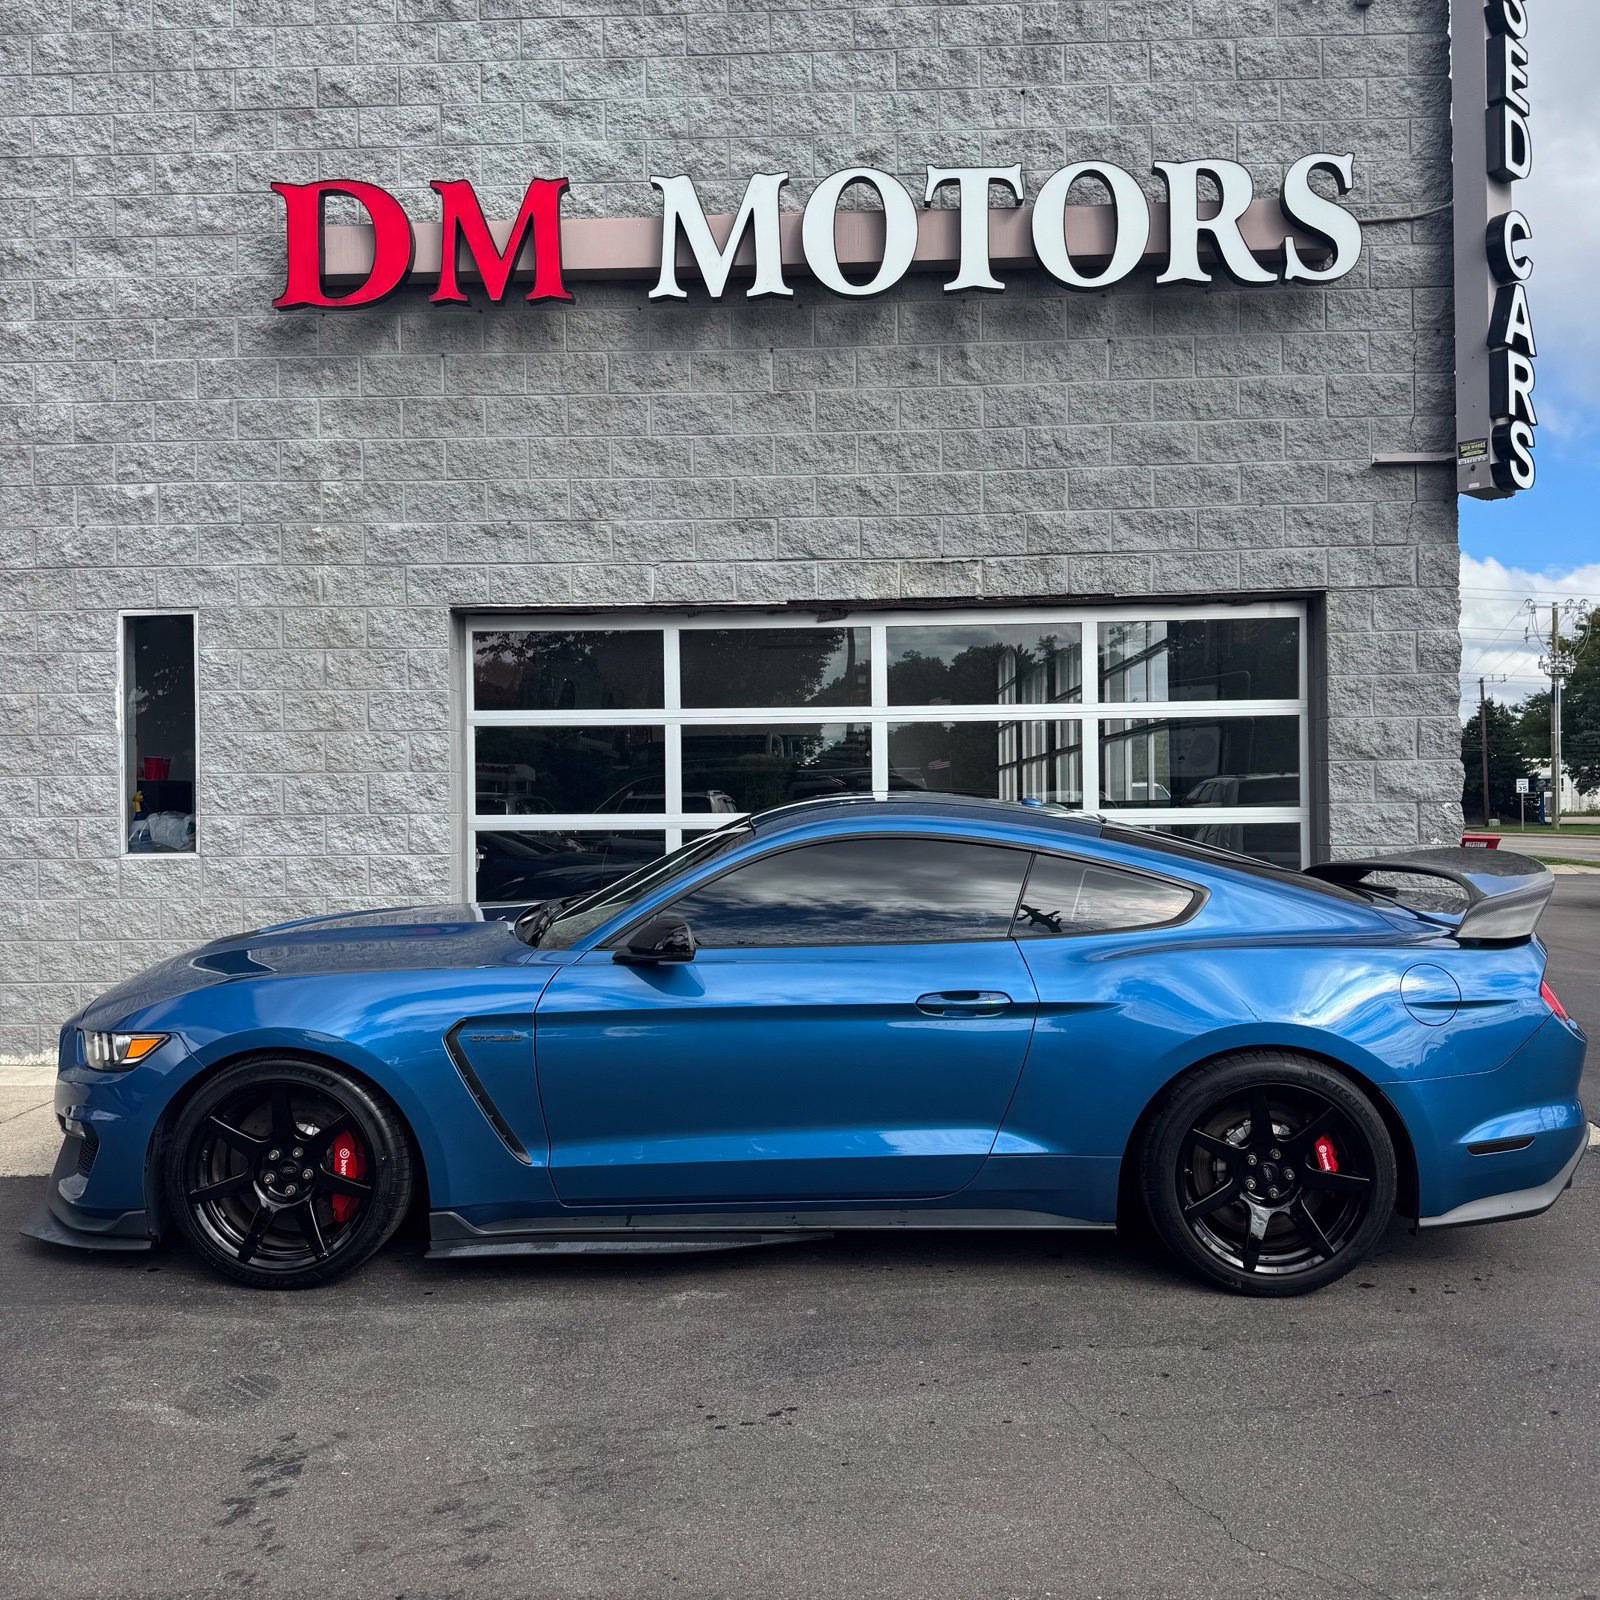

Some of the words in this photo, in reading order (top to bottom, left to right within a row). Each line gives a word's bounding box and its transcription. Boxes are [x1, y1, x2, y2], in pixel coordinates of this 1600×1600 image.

[271, 177, 576, 308] DM
[649, 152, 1362, 301] MOTORS
[1497, 210, 1538, 489] CARS
